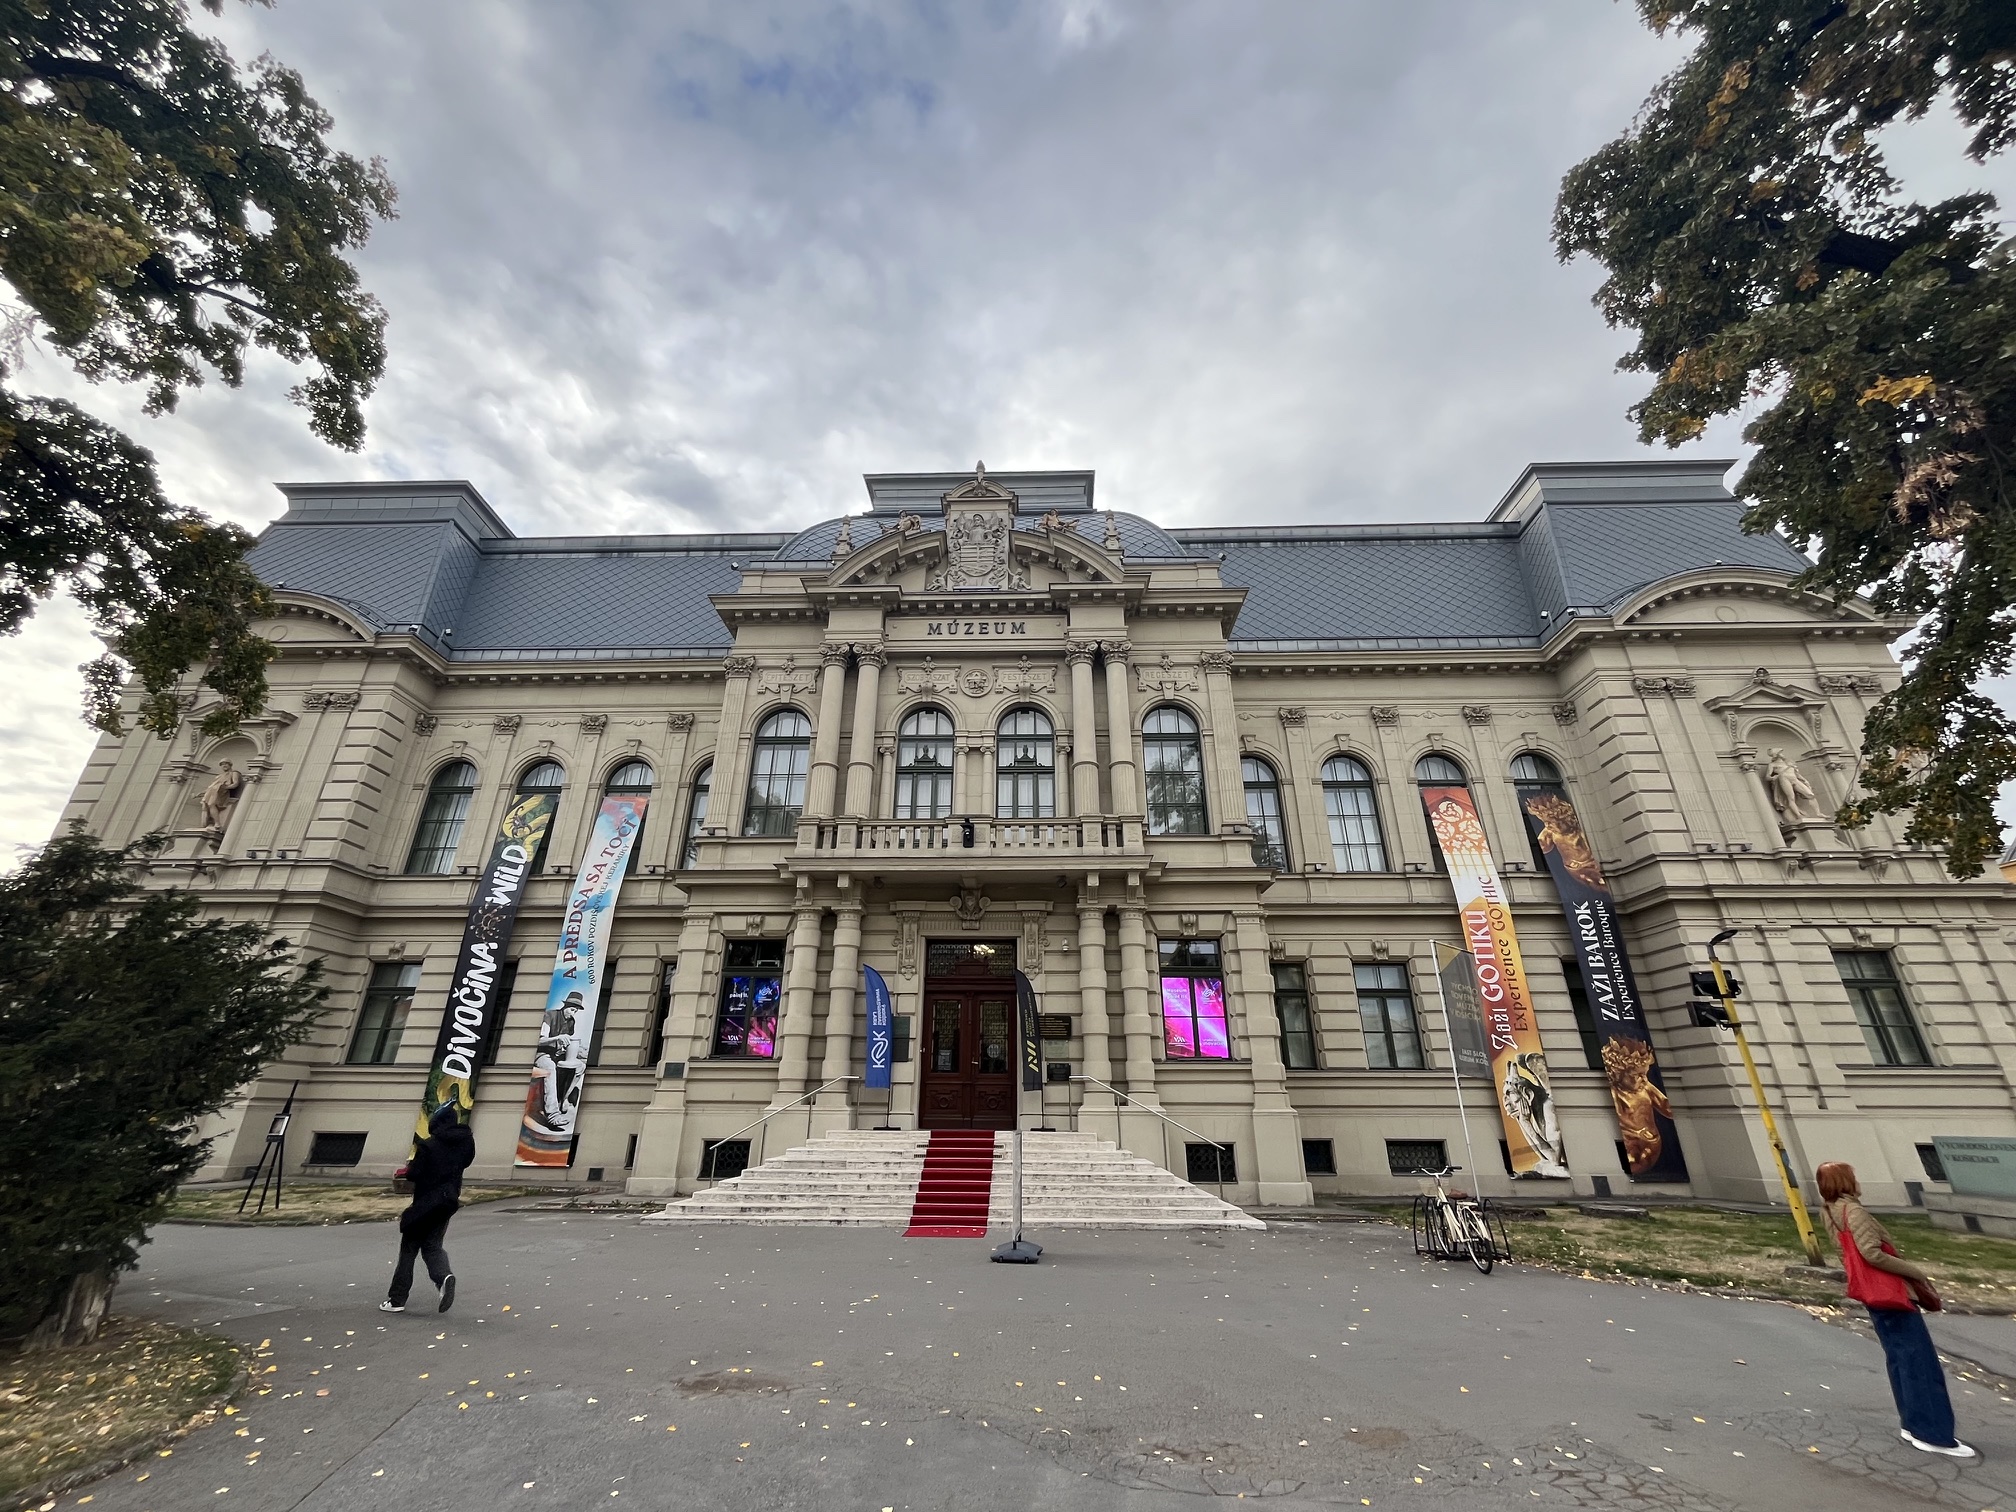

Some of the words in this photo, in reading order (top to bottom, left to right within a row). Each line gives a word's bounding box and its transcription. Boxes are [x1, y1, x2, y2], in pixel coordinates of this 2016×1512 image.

[927, 618, 1026, 636] MÚZEUM
[600, 818, 637, 858] TOČÍ
[605, 843, 630, 880] KERAMIKY
[585, 862, 608, 884] SA
[563, 888, 593, 962] PREDSA
[1478, 876, 1506, 932] GOTHIC
[1594, 899, 1616, 948] Baroque
[586, 940, 595, 970] ROKOV
[1465, 909, 1505, 1002] GOTIKU
[1572, 900, 1606, 968] BAROK
[563, 966, 577, 979] A
[588, 970, 596, 985] 600
[1498, 938, 1529, 1032] Experience
[1609, 952, 1636, 1020] Experience
[1590, 973, 1620, 1021] ZAŽI
